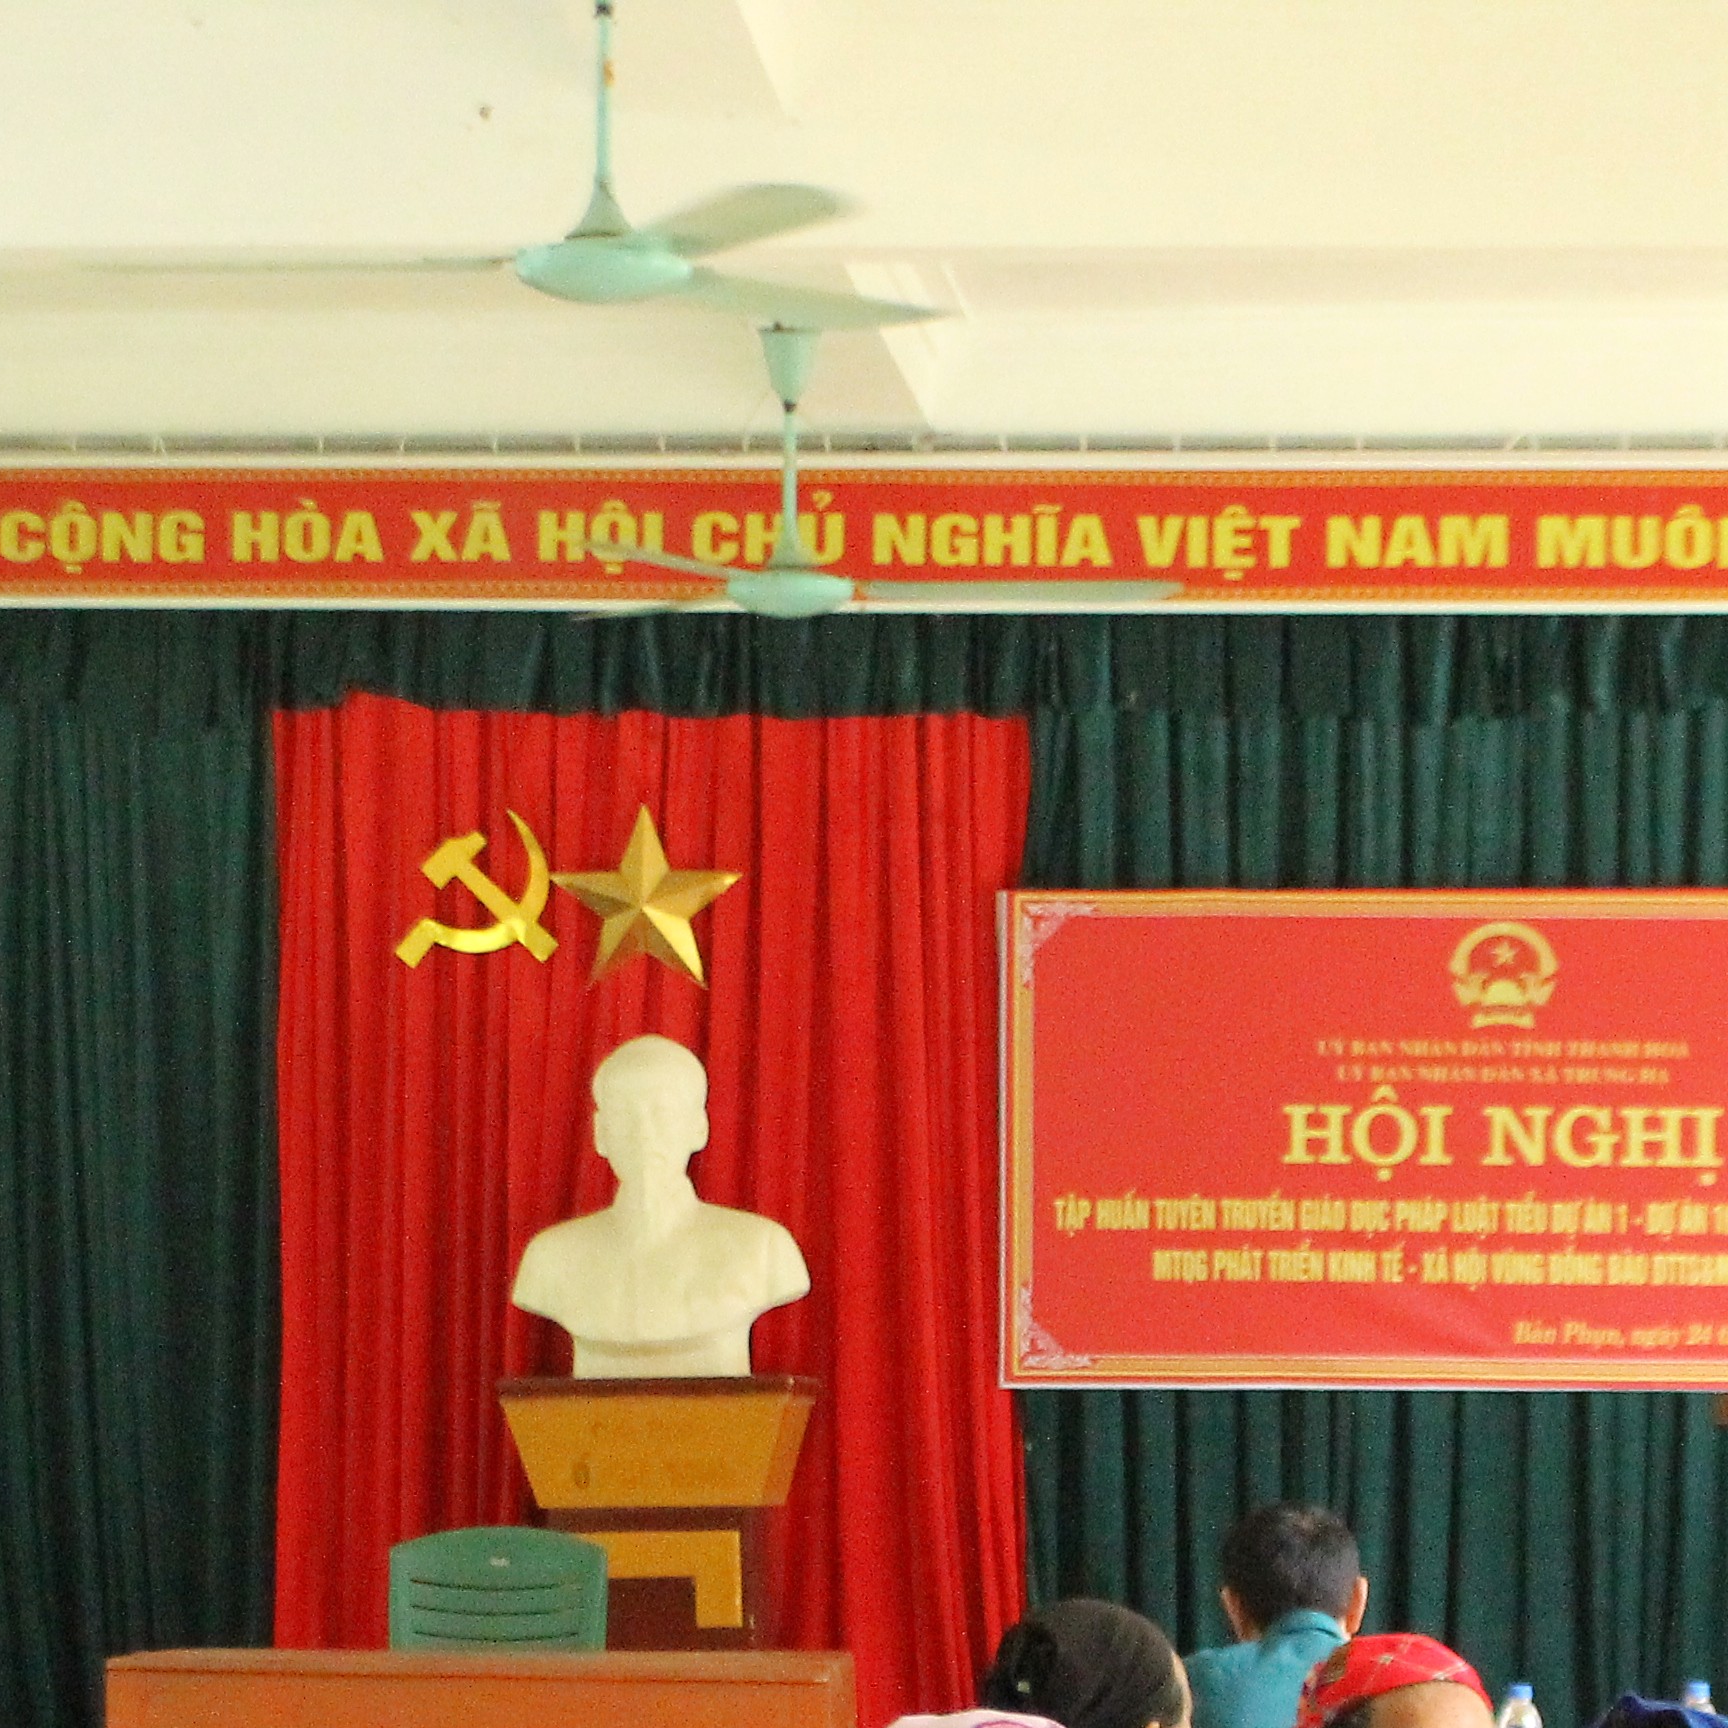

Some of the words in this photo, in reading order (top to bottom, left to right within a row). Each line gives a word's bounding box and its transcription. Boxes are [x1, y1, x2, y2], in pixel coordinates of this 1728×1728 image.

[0, 500, 205, 574] CỘNG
[231, 498, 383, 563] HÒA
[411, 500, 511, 563] XÃ
[538, 500, 664, 574] HỘI
[692, 490, 844, 567] CHỦ
[872, 503, 1112, 567] NGHĨA
[1136, 503, 1302, 580] VIỆT
[1326, 514, 1509, 569] NAM
[1282, 1085, 1454, 1182] HỘI
[1482, 1105, 1724, 1186] NGHỊ
[1054, 1193, 1092, 1237] TẬP
